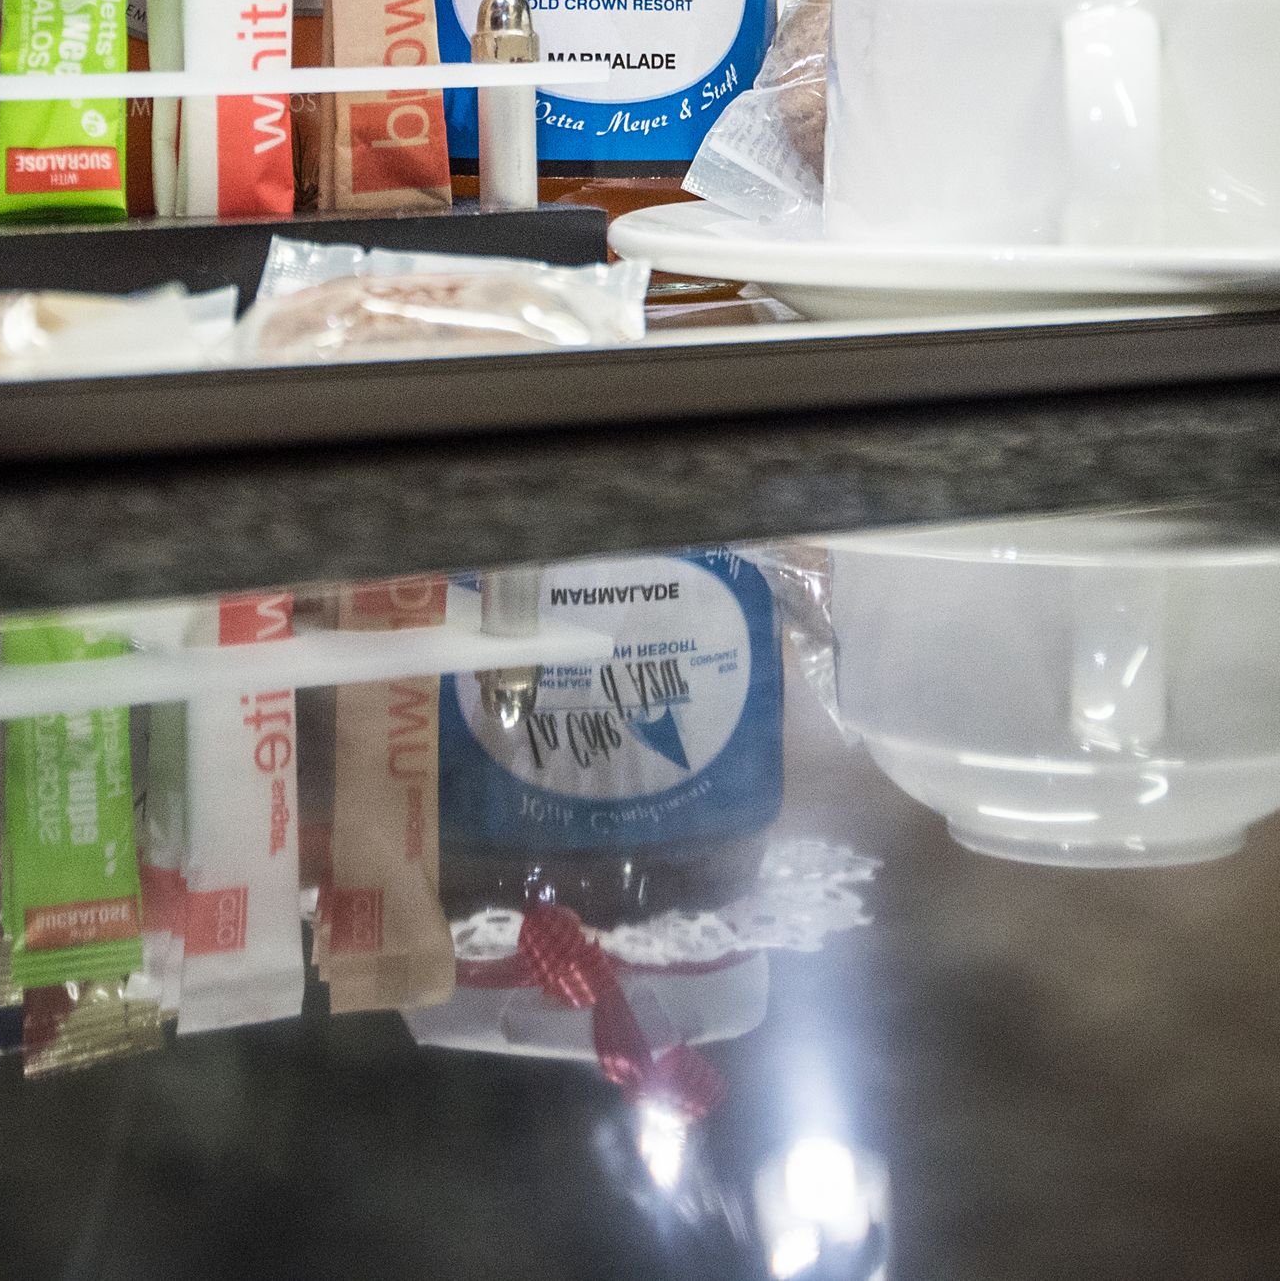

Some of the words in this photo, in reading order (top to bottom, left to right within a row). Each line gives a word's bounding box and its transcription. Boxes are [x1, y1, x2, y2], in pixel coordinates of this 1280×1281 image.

[547, 52, 677, 71] MARMALADE
[596, 114, 669, 137] Meyer
[679, 97, 693, 119] &
[700, 62, 739, 111] Staff
[15, 152, 113, 173] SUCRALOSE
[50, 173, 80, 185] WITH
